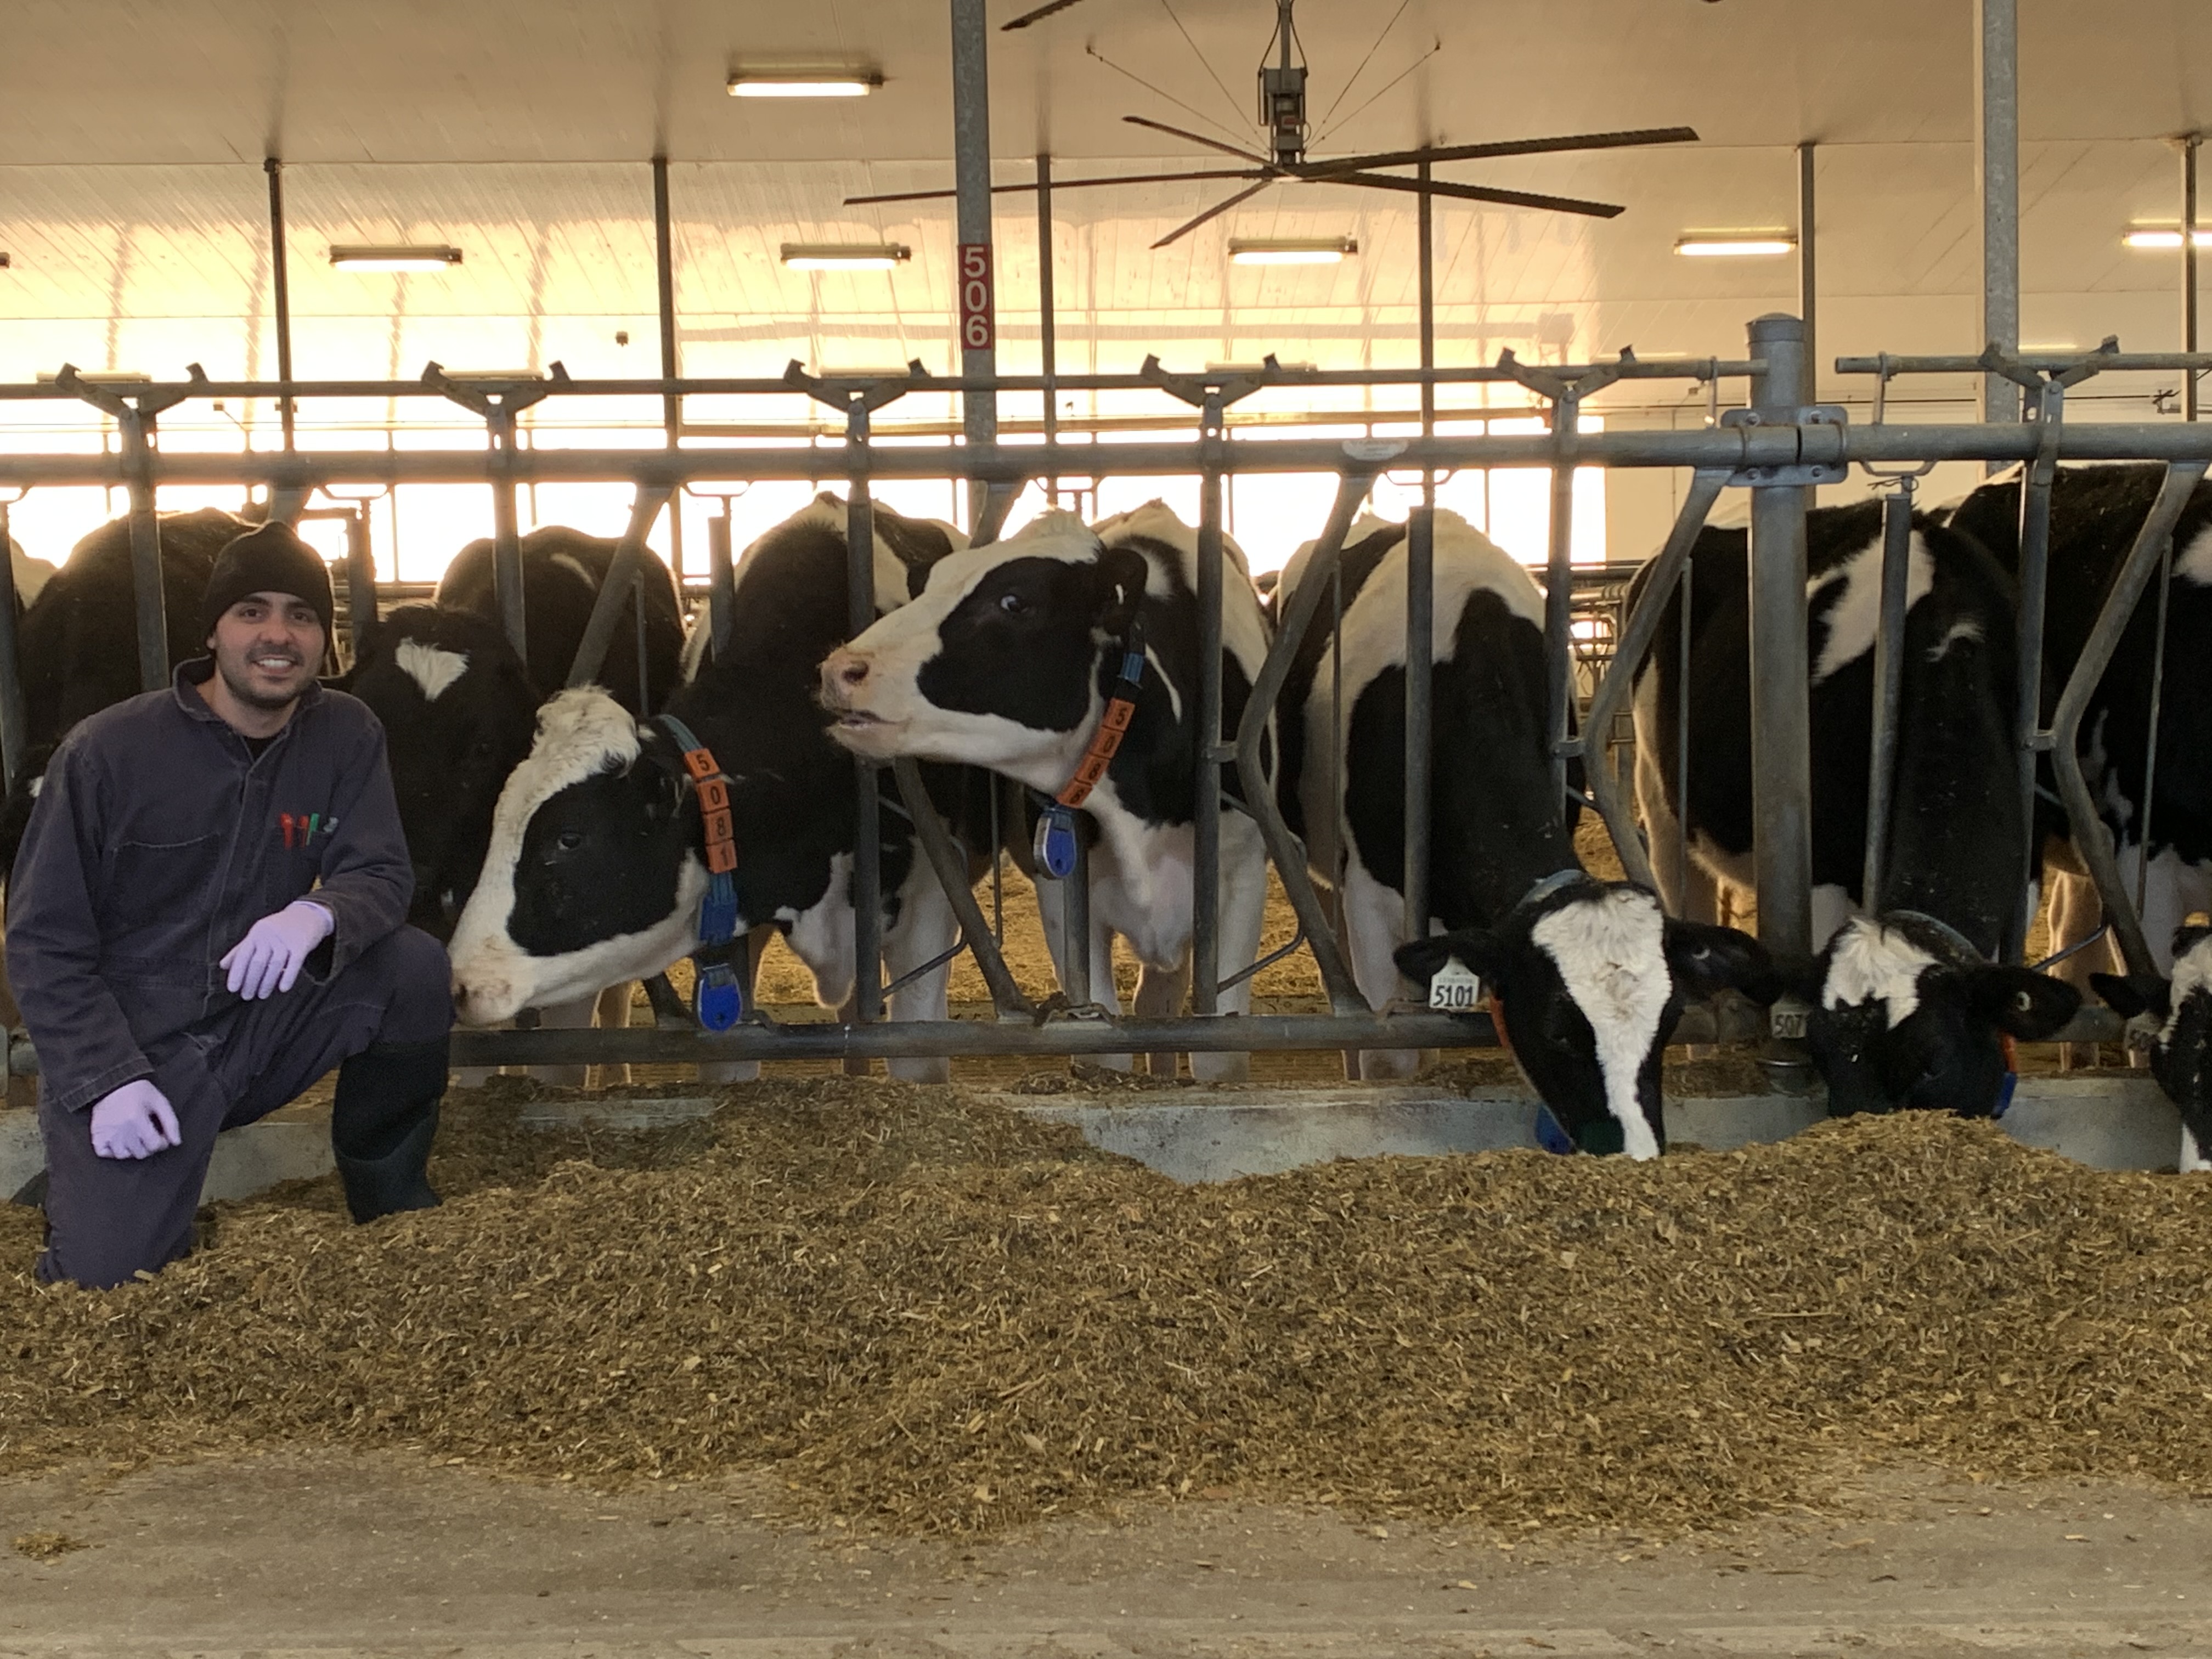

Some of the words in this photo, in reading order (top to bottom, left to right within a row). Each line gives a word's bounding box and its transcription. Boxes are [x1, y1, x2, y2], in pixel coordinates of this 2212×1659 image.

[964, 246, 988, 346] 506
[695, 753, 729, 868] 5081
[1432, 985, 1473, 1006] 5101
[1773, 1014, 1805, 1036] 507
